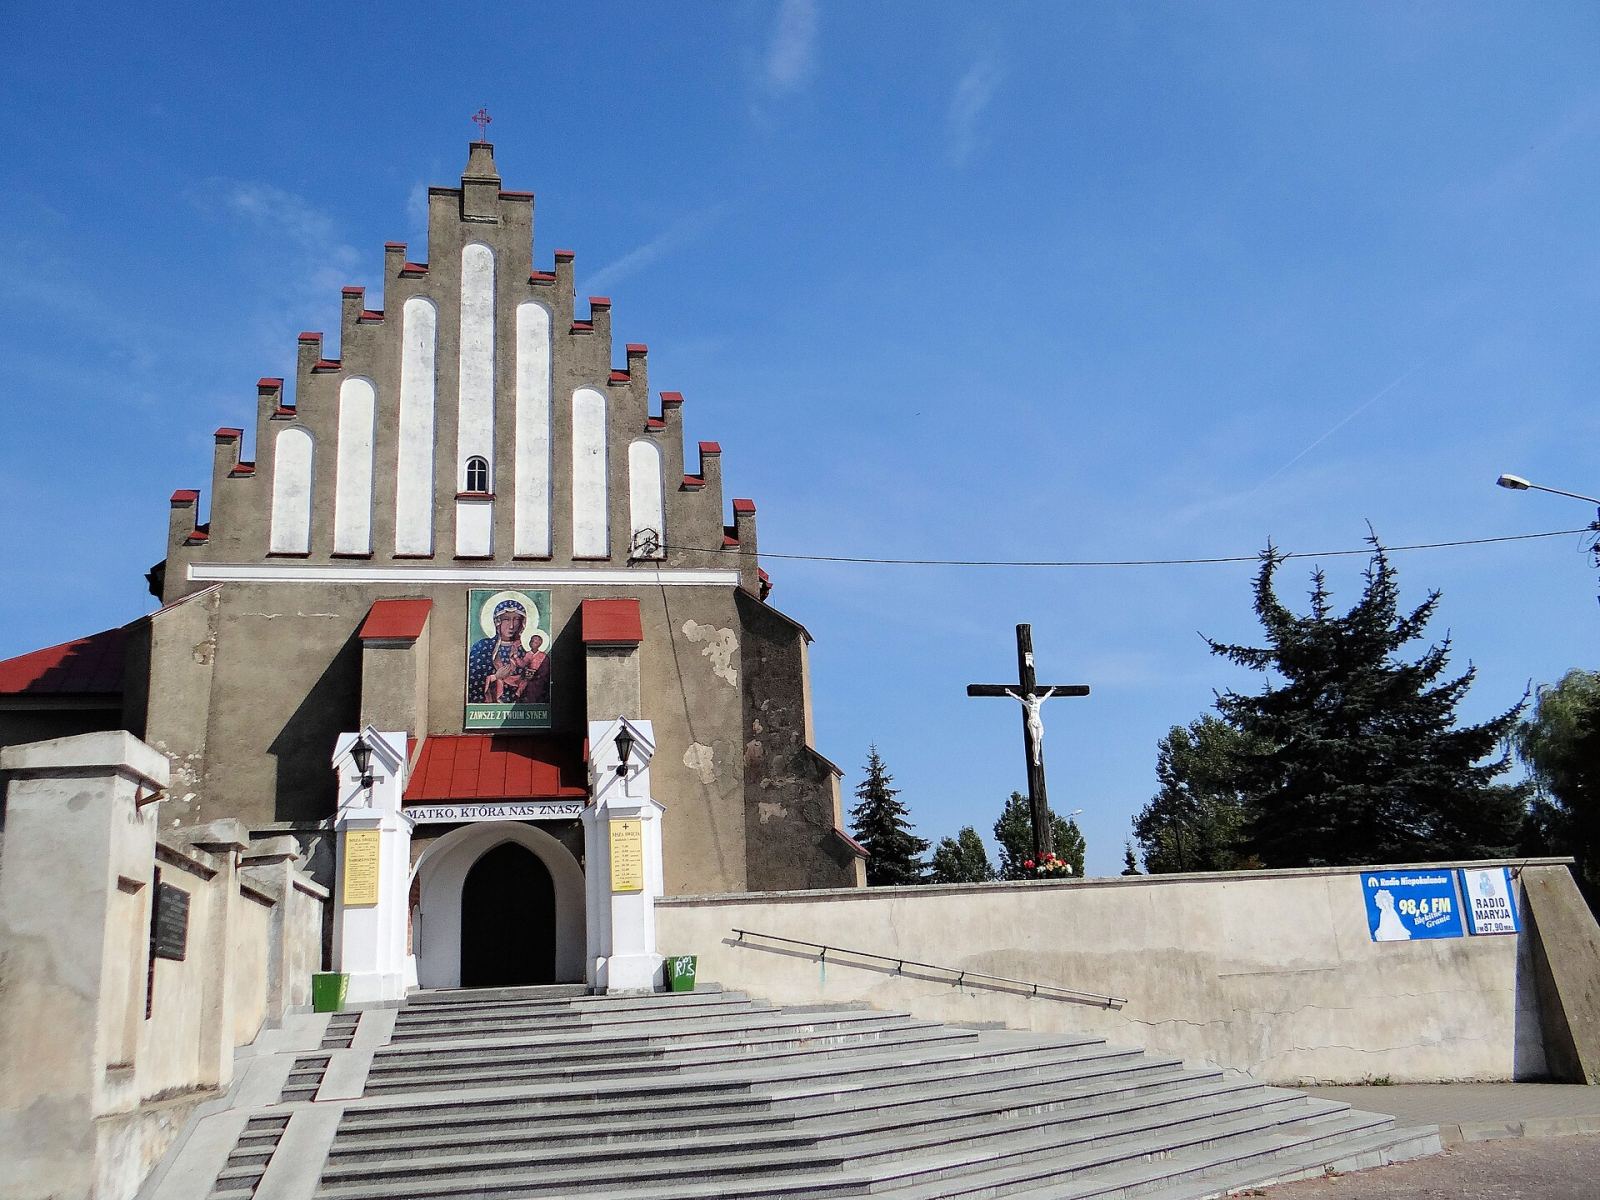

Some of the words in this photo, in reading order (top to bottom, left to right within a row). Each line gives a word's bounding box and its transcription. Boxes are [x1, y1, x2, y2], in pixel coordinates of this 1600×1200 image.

[469, 710, 496, 720] ZAWSZE
[496, 710, 502, 720] Z
[502, 710, 525, 720] TWOIM
[526, 710, 548, 720] SYNEM
[460, 804, 506, 817] KTÓRA
[508, 805, 535, 816] NAS
[539, 804, 580, 815] ZNASZ
[1380, 877, 1400, 887] Radio
[1398, 898, 1429, 917] 98,6
[1431, 897, 1452, 913] FM
[1475, 897, 1505, 909] RADIO
[1475, 909, 1511, 920] MARYJA
